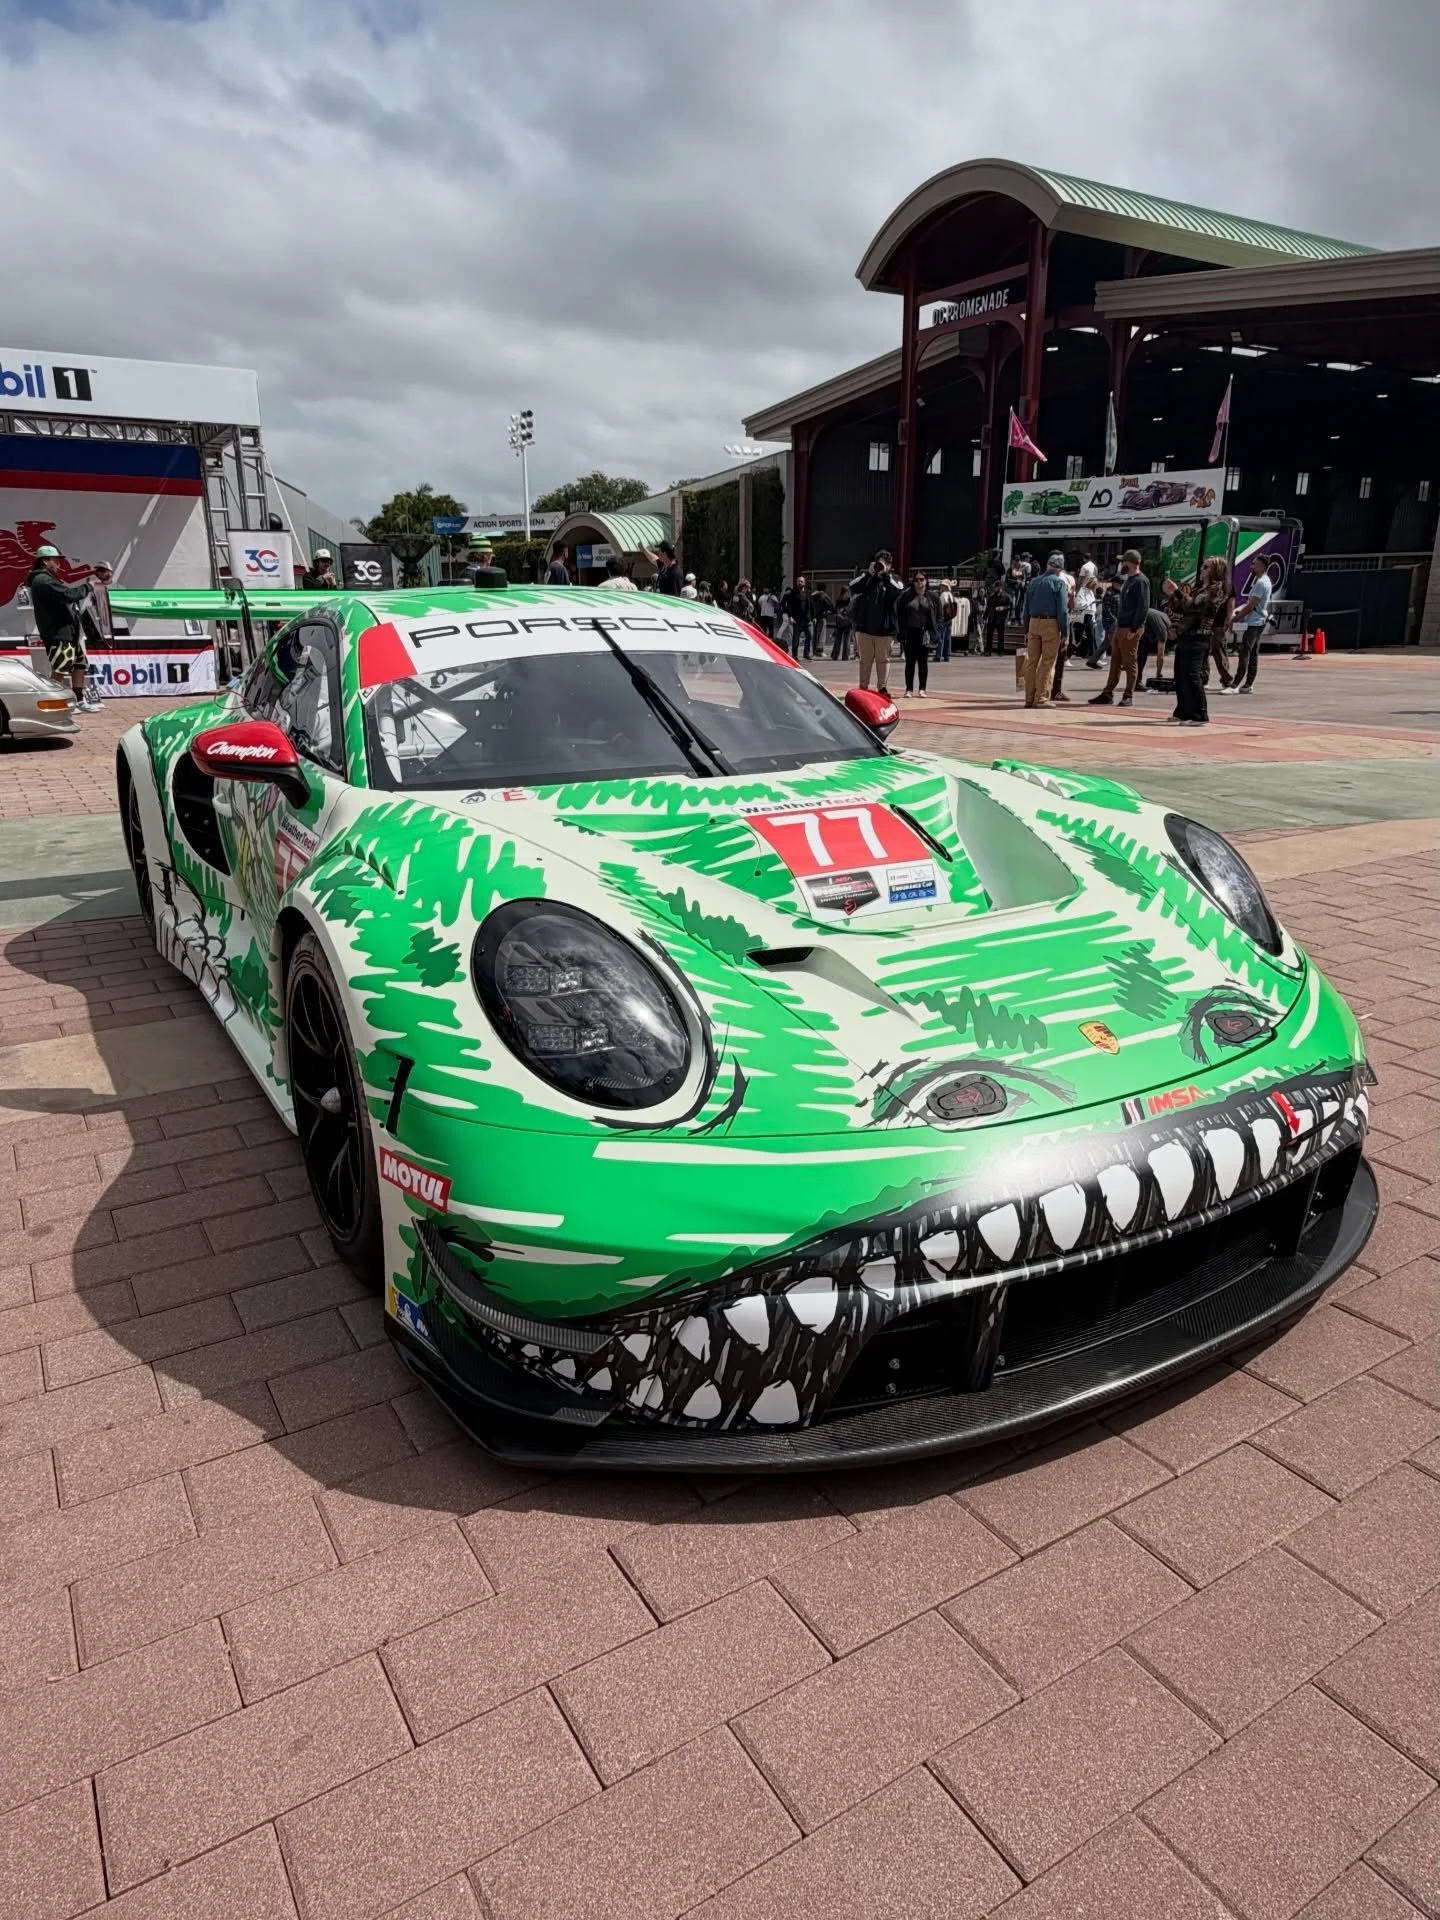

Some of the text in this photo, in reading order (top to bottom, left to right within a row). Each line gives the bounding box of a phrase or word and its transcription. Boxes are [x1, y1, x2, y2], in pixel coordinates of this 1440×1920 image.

[932, 288, 1010, 326] DC PROMENADE
[473, 520, 497, 530] ACTION
[498, 518, 522, 528] SPORTS
[408, 616, 749, 648] PORSCHE
[87, 662, 162, 686] Mobil
[206, 740, 278, 760] Champion
[740, 796, 868, 815] WeatherTech
[281, 815, 319, 853] WeatherTech
[765, 807, 889, 867] 77
[1146, 1085, 1207, 1115] IMSA
[383, 1153, 444, 1208] MOTUL
